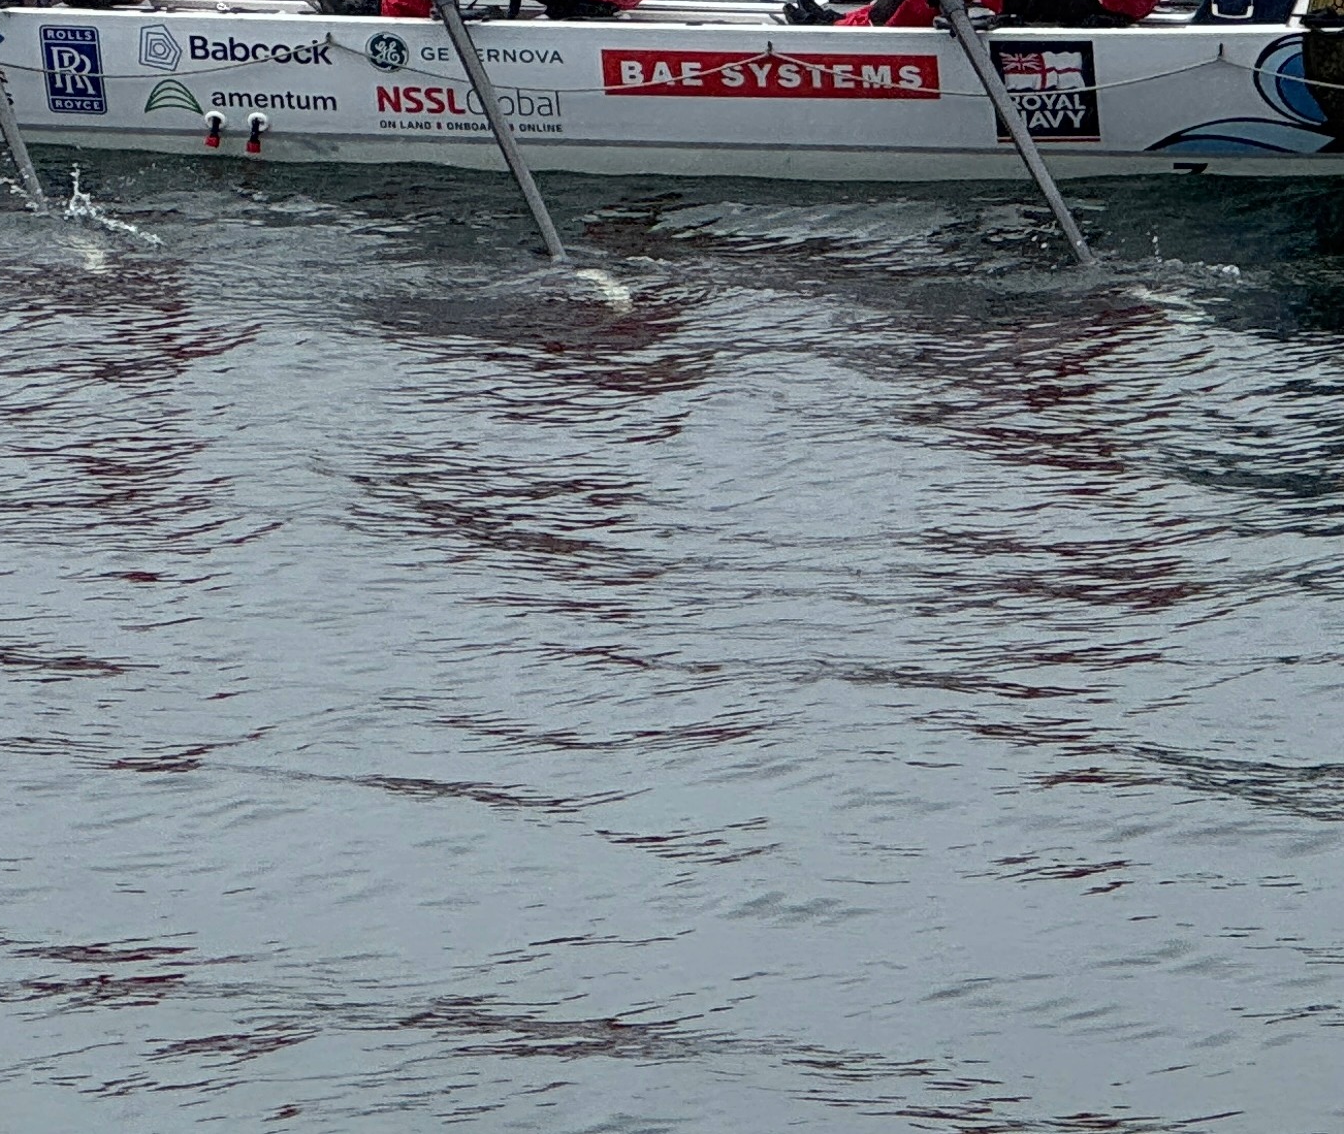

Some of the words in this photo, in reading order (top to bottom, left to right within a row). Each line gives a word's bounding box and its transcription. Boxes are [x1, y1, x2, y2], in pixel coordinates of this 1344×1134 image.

[46, 29, 93, 41] ROLLS
[189, 35, 333, 65] Babcock
[420, 47, 450, 61] GE
[620, 60, 703, 87] BAE
[720, 62, 924, 89] SYSTEMS
[55, 99, 101, 110] ROYCE
[211, 90, 338, 111] amentum
[380, 120, 397, 130] ON
[400, 120, 432, 130] LAND
[518, 123, 563, 133] ONLINE
